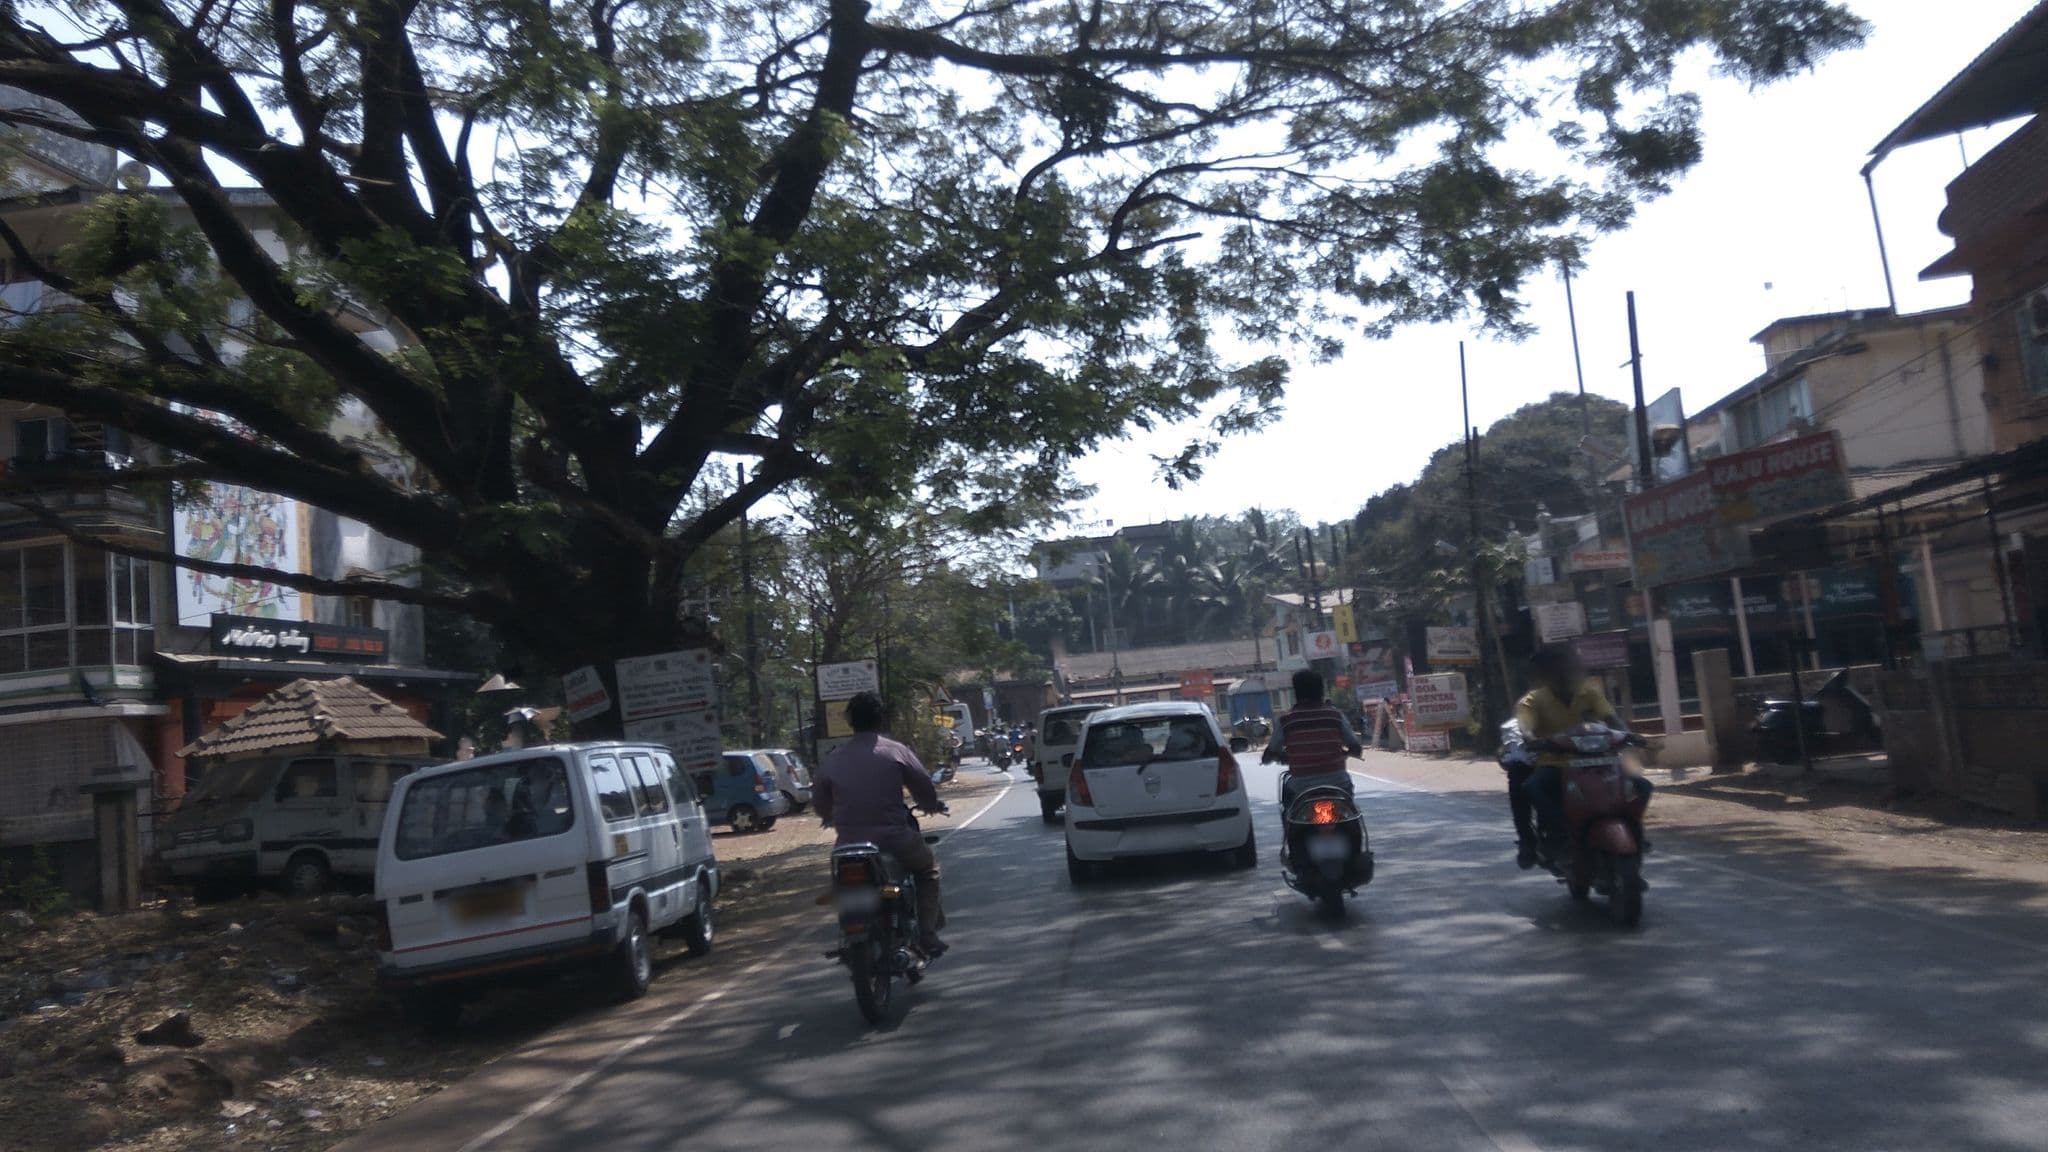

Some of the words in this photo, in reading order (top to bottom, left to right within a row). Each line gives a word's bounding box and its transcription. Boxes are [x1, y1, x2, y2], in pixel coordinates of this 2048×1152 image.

[1713, 459, 1762, 485] KAJU
[1766, 441, 1832, 473] HOUSE
[1417, 693, 1456, 703] DENTAL
[1418, 703, 1457, 713] STUDIO
